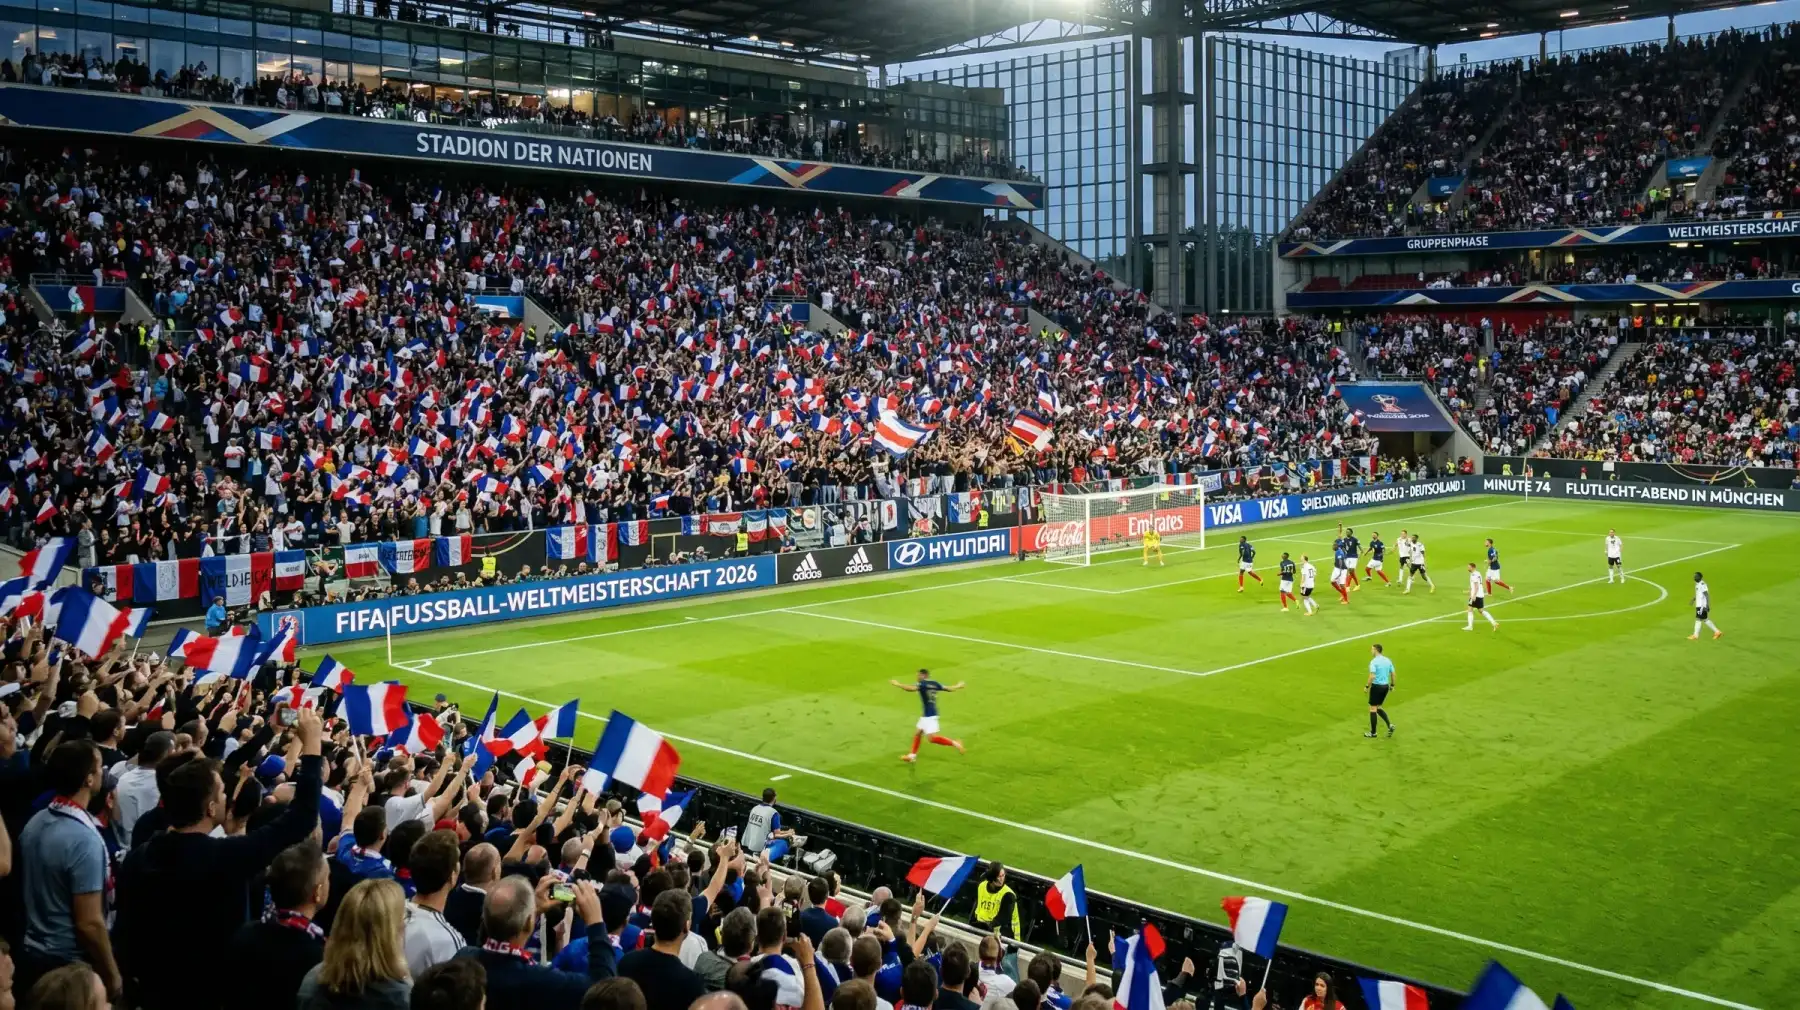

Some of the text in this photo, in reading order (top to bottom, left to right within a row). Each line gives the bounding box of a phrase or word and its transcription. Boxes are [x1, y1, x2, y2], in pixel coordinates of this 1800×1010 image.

[416, 132, 652, 171] STADION DER NATIONEN
[1668, 221, 1800, 238] WELTMEISTERSCHAF
[1407, 236, 1489, 249] GRUPPENPHASE
[1301, 494, 1351, 512] SPIELSTAND:
[1352, 487, 1399, 505] FRANKREICH
[1410, 480, 1460, 498] DEUTSCHLAND
[1483, 478, 1551, 493] MINUTE 74
[1566, 482, 1784, 507] FLUTLICHT-ABEND IN MÜNCHEN
[1210, 504, 1243, 526] VISA
[1258, 498, 1289, 520] VISA
[929, 534, 1005, 560] HYUNDAI
[792, 568, 822, 582] adidas
[844, 562, 873, 576] adidas
[336, 563, 757, 634] FIFA FUSSBALL-WELTMEISTERSCHAFT 2026
